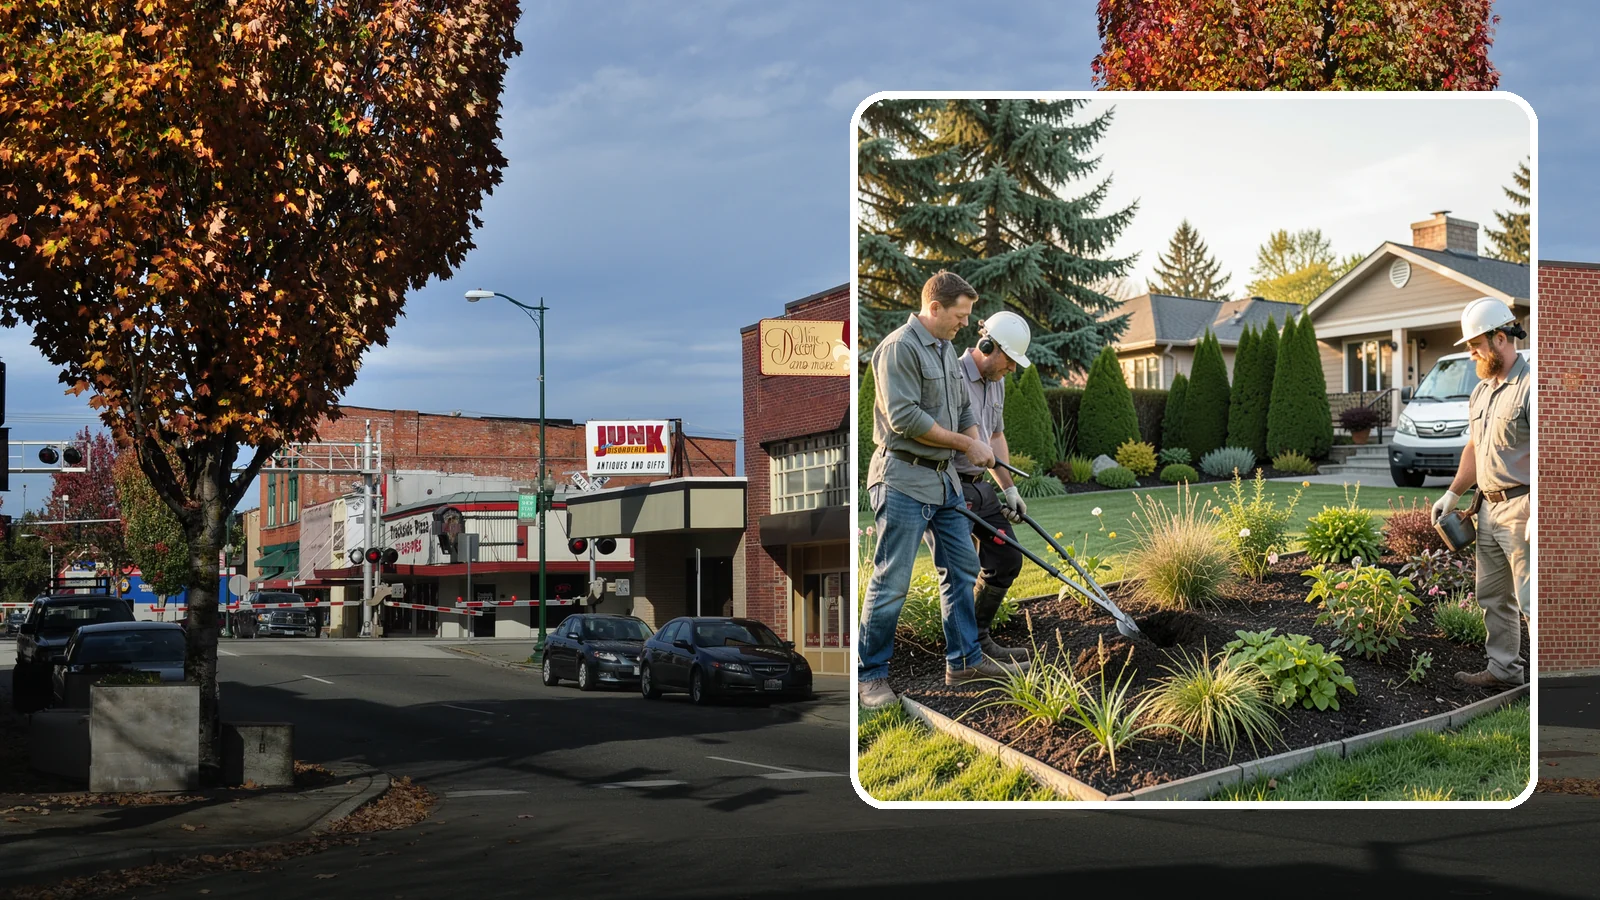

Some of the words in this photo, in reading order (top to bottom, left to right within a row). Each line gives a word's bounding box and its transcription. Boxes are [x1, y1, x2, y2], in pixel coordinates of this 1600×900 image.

[595, 425, 665, 457] JUNK
[607, 446, 646, 455] DISORDERLY
[597, 461, 628, 470] ANTIQUES
[631, 461, 644, 470] AND
[647, 460, 665, 470] GIFTS
[414, 519, 429, 535] Pizza
